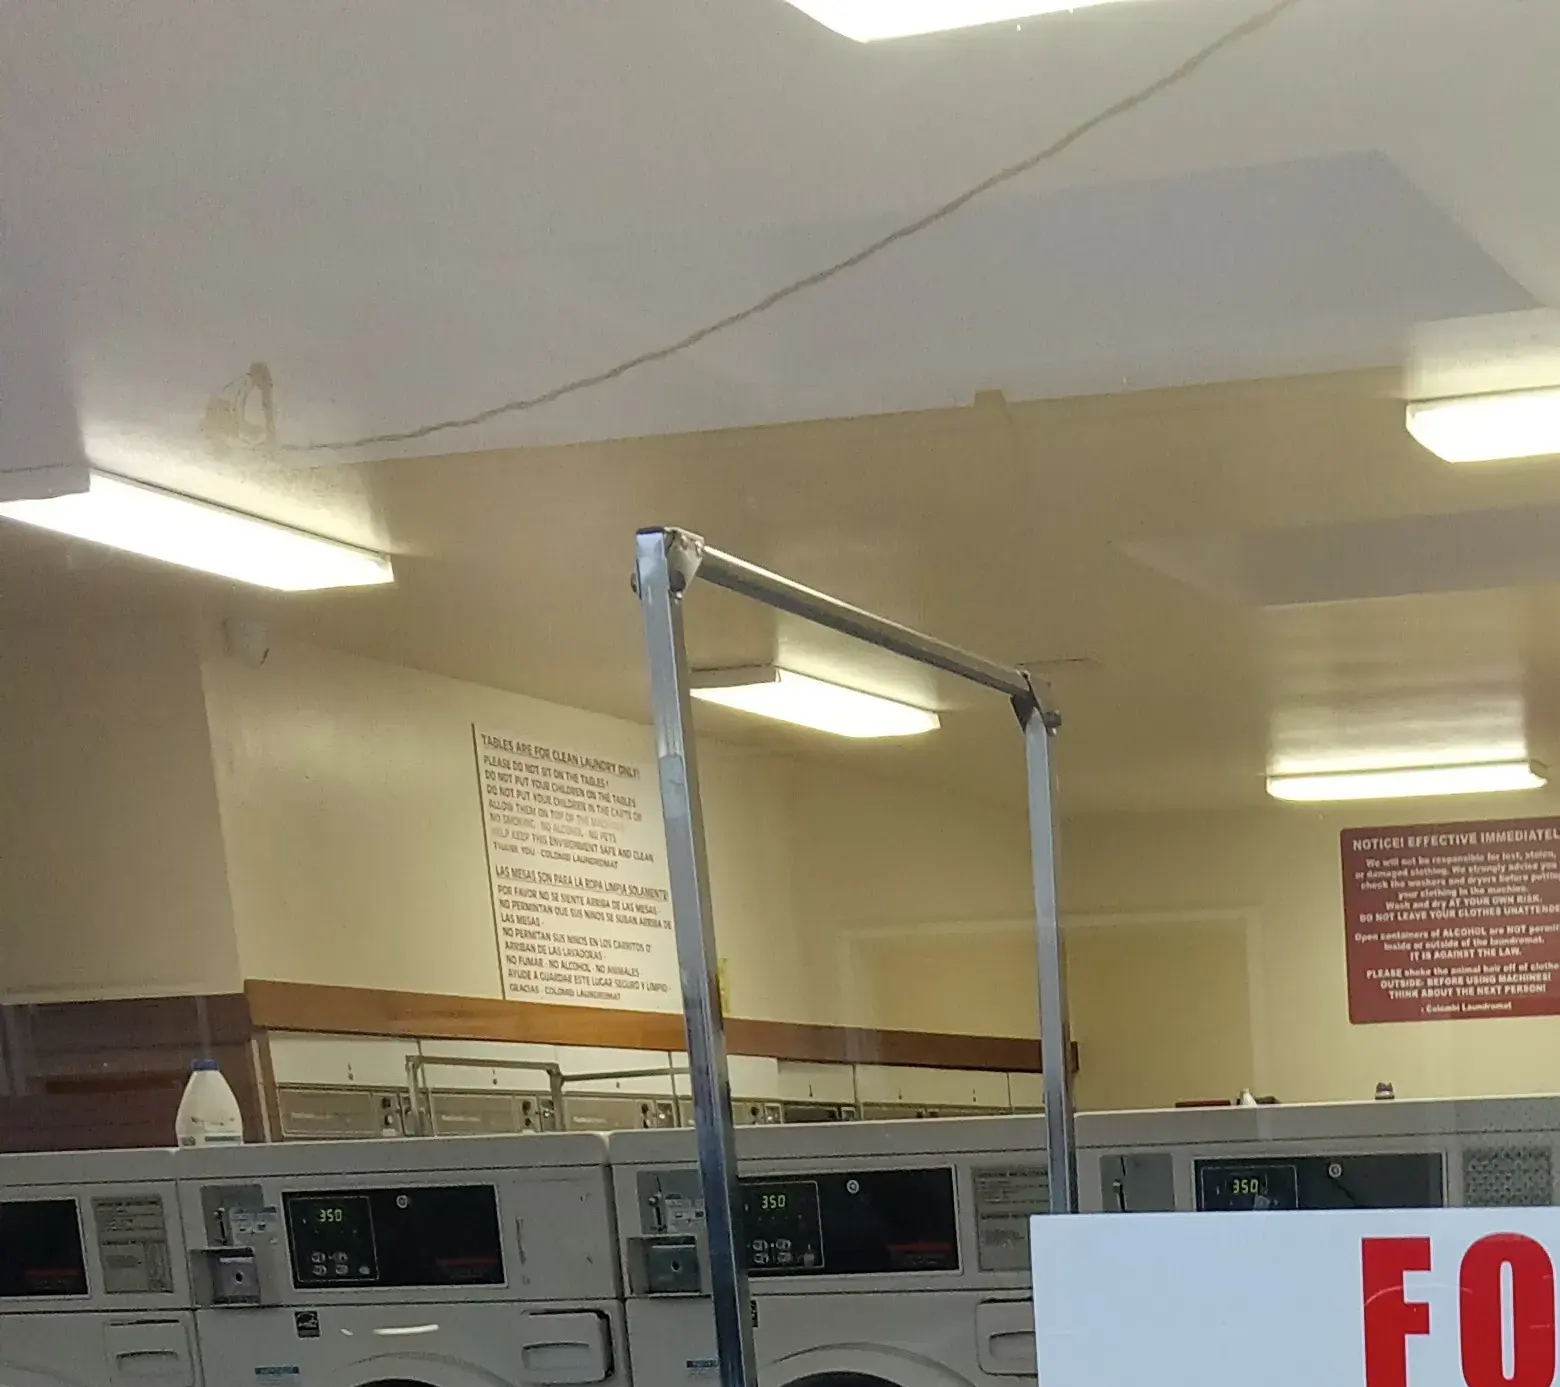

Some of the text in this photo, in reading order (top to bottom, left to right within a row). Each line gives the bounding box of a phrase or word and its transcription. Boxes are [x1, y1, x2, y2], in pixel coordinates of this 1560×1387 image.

[1352, 837, 1403, 851] NOTICE!
[1407, 833, 1476, 848] EFFECTIVE
[1385, 901, 1410, 911] Wash
[1448, 899, 1460, 908] AT
[1463, 897, 1489, 907] YOUR
[1492, 896, 1514, 906] OWN
[1359, 913, 1372, 923] DO
[1375, 912, 1394, 922] NOT
[1397, 911, 1426, 921] LEAVE
[1429, 909, 1455, 920] YOUR
[1458, 907, 1501, 918] CLOTHES
[1380, 929, 1428, 942] containers
[1442, 927, 1486, 939] ALCOHOL
[1506, 925, 1526, 936] NOT
[1410, 952, 1419, 961] IT
[1421, 951, 1431, 960] IS
[1433, 949, 1474, 960] AGAINST
[1477, 948, 1496, 958] THE
[1366, 968, 1402, 979] PLEASE
[1426, 976, 1463, 987] BEFORE
[1466, 975, 1496, 985] USING
[1389, 989, 1418, 999] THINK
[1421, 988, 1453, 998] ABOUT
[1455, 987, 1474, 996] THE
[1476, 986, 1501, 995] NEXT
[1233, 1178, 1260, 1194] 350
[762, 1194, 786, 1209] 350
[320, 1208, 343, 1222] 350
